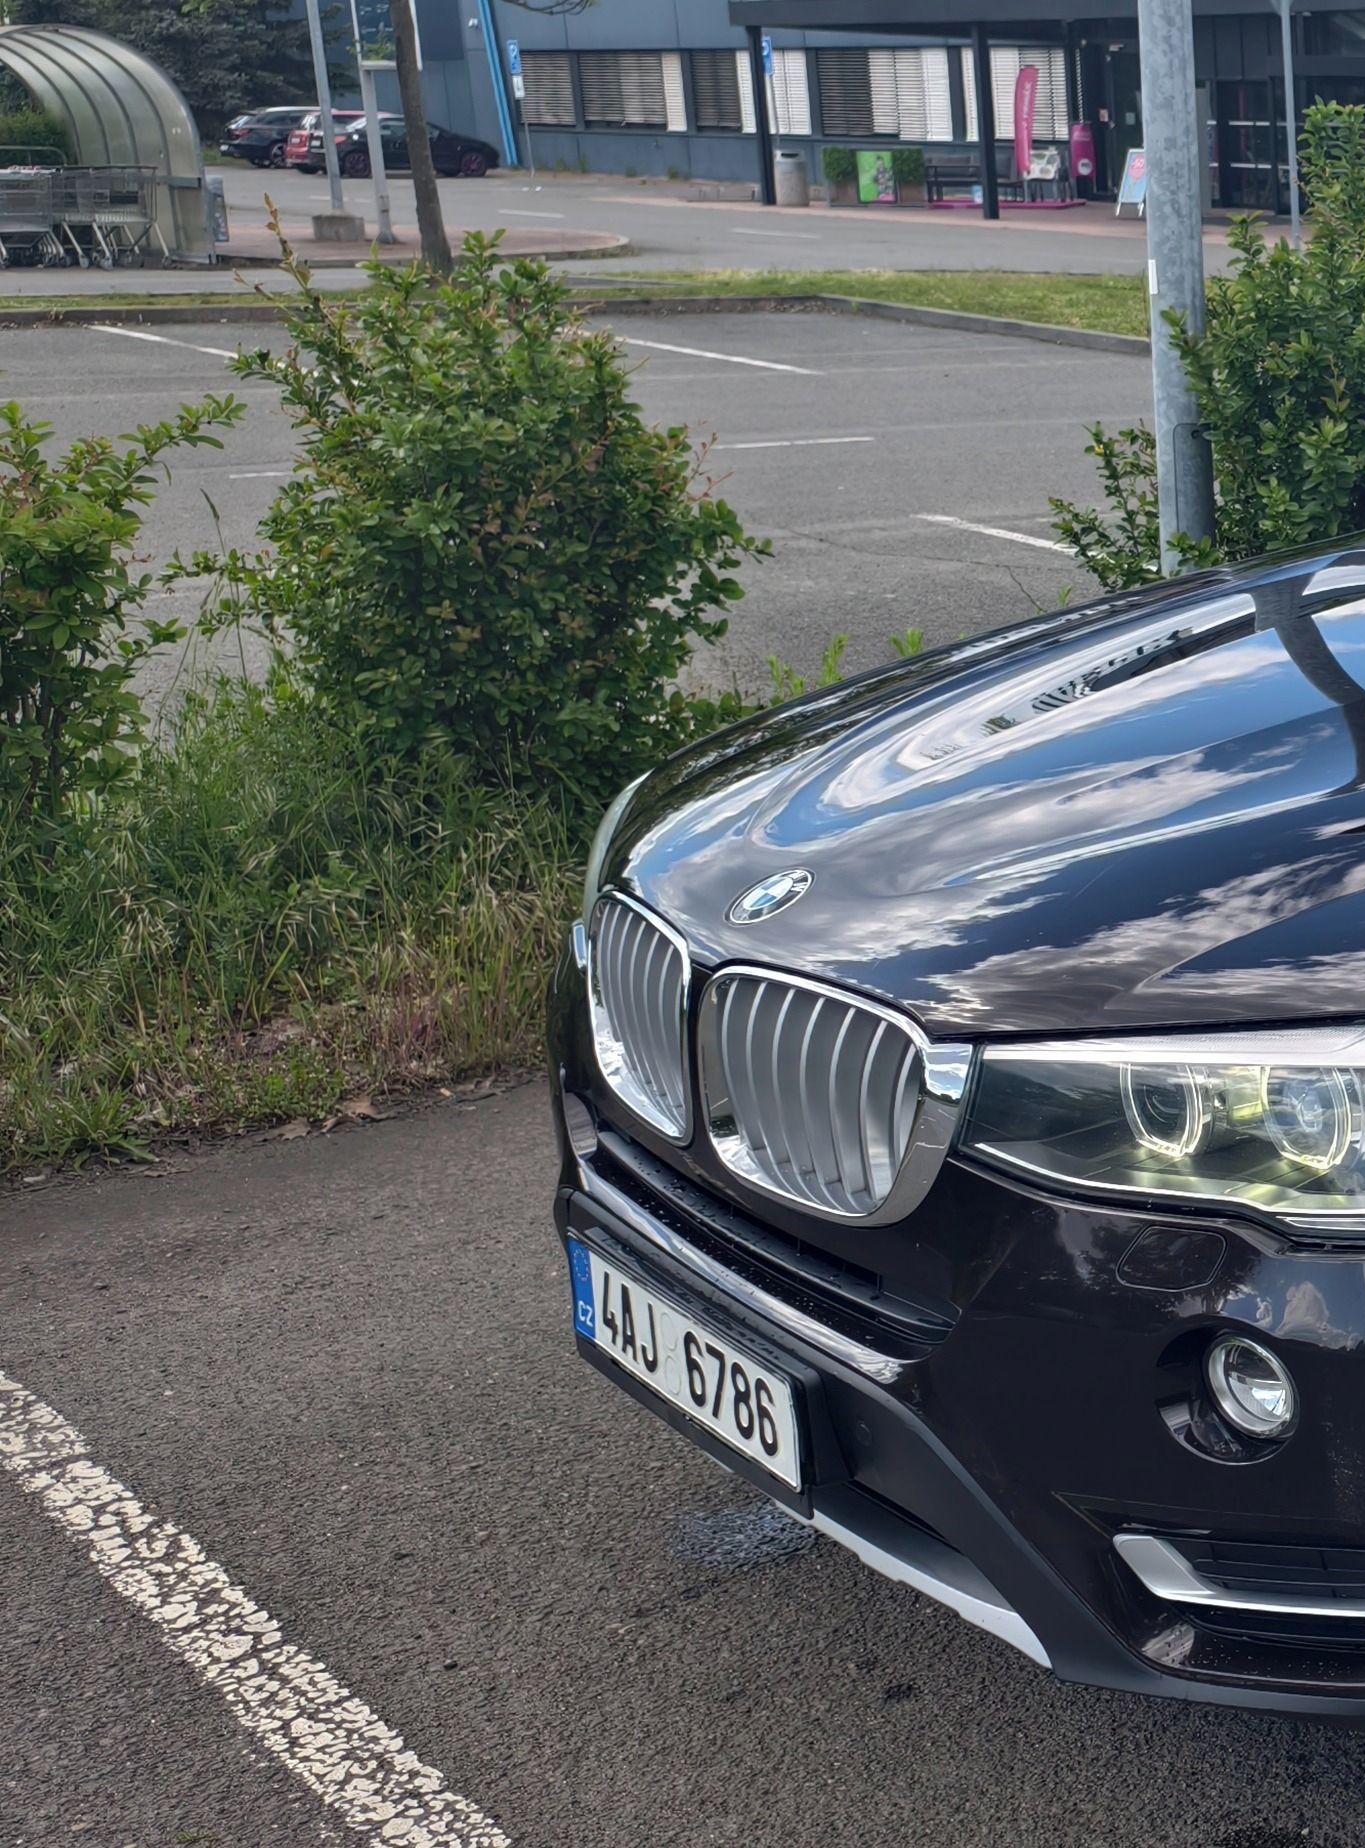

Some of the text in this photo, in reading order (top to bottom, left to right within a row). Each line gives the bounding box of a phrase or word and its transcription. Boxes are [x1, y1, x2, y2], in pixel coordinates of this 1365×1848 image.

[578, 1300, 593, 1327] CZ
[602, 1271, 778, 1456] 4AJ 6786
